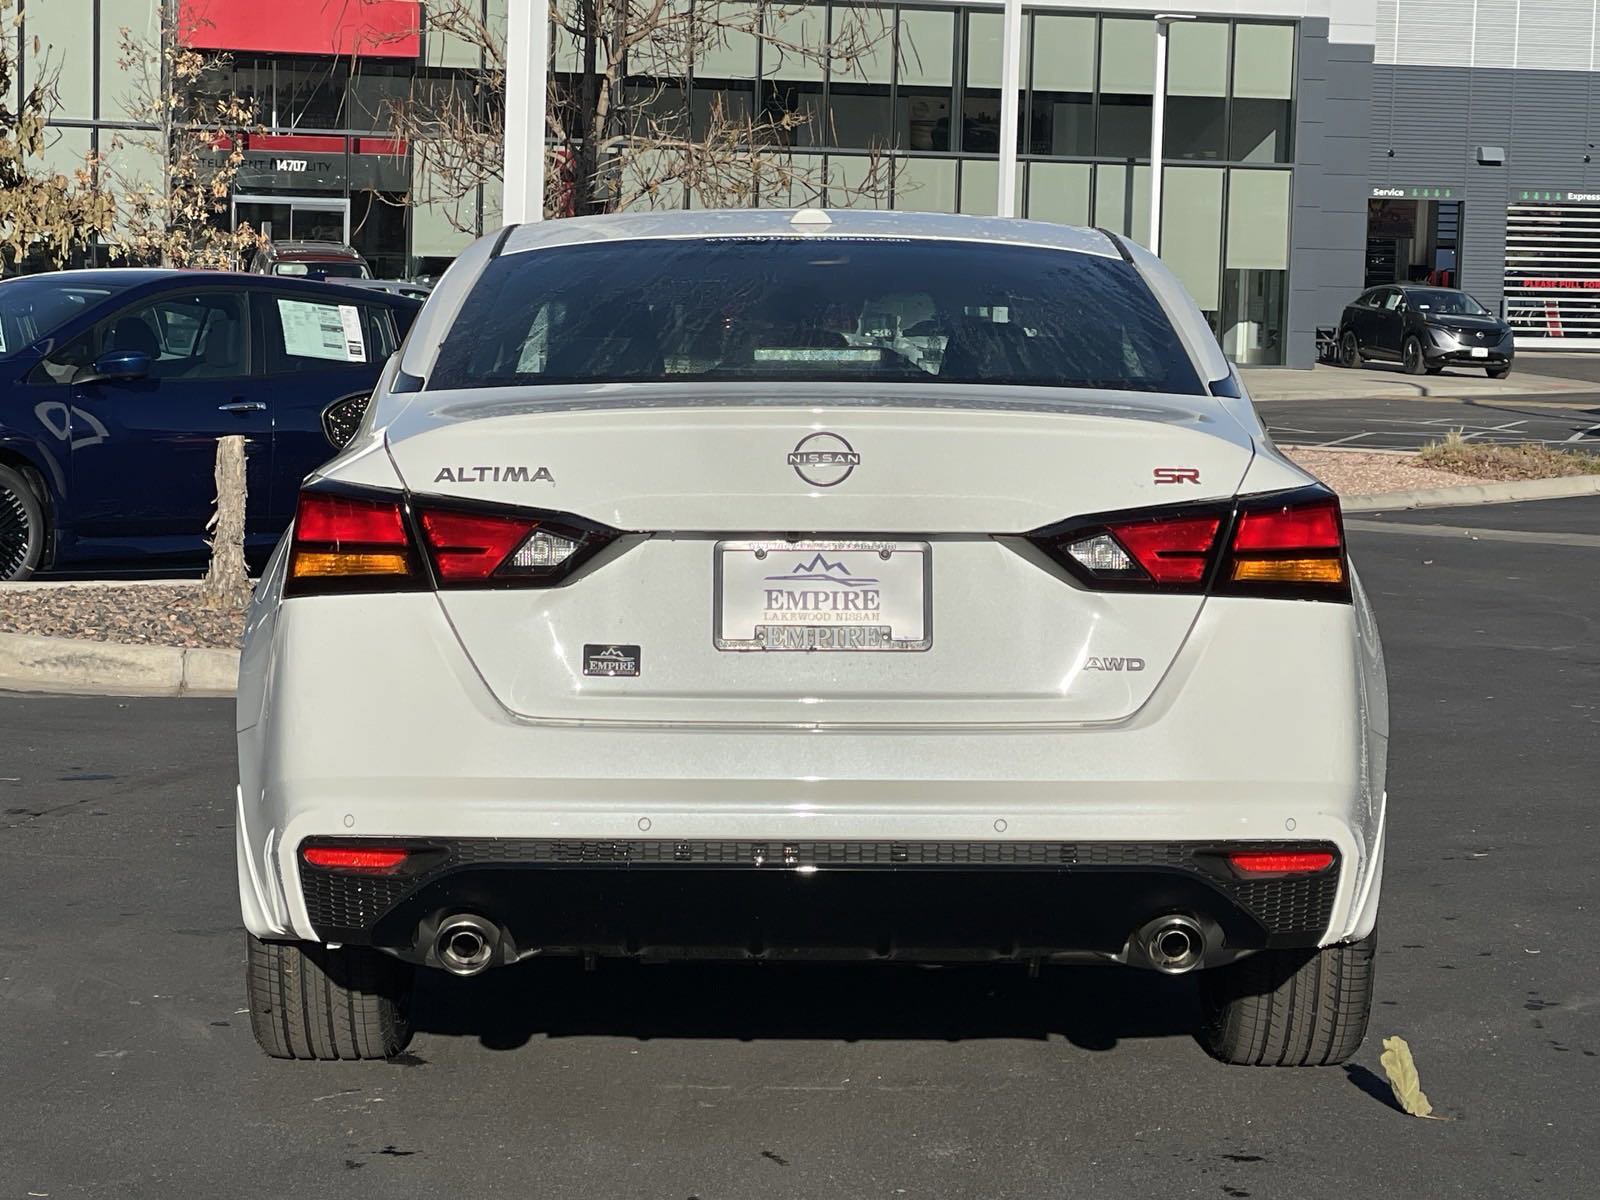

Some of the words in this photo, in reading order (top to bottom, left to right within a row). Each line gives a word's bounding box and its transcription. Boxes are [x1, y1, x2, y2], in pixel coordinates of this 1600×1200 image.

[276, 159, 307, 171] 14707
[1373, 187, 1404, 197] Service
[1567, 192, 1600, 202] Express
[1523, 280, 1555, 288] PLEASE
[1560, 280, 1579, 289] PULL
[789, 453, 859, 464] NISSAN
[434, 467, 554, 482] ALTIMA
[1153, 468, 1201, 485] SR
[763, 589, 880, 611] EMPIRE
[764, 612, 831, 621] LAKEWOOD
[836, 612, 880, 621] NISSAN
[765, 626, 882, 648] EMPIRE
[589, 660, 635, 671] EMPIRE
[1084, 657, 1145, 671] AWD
